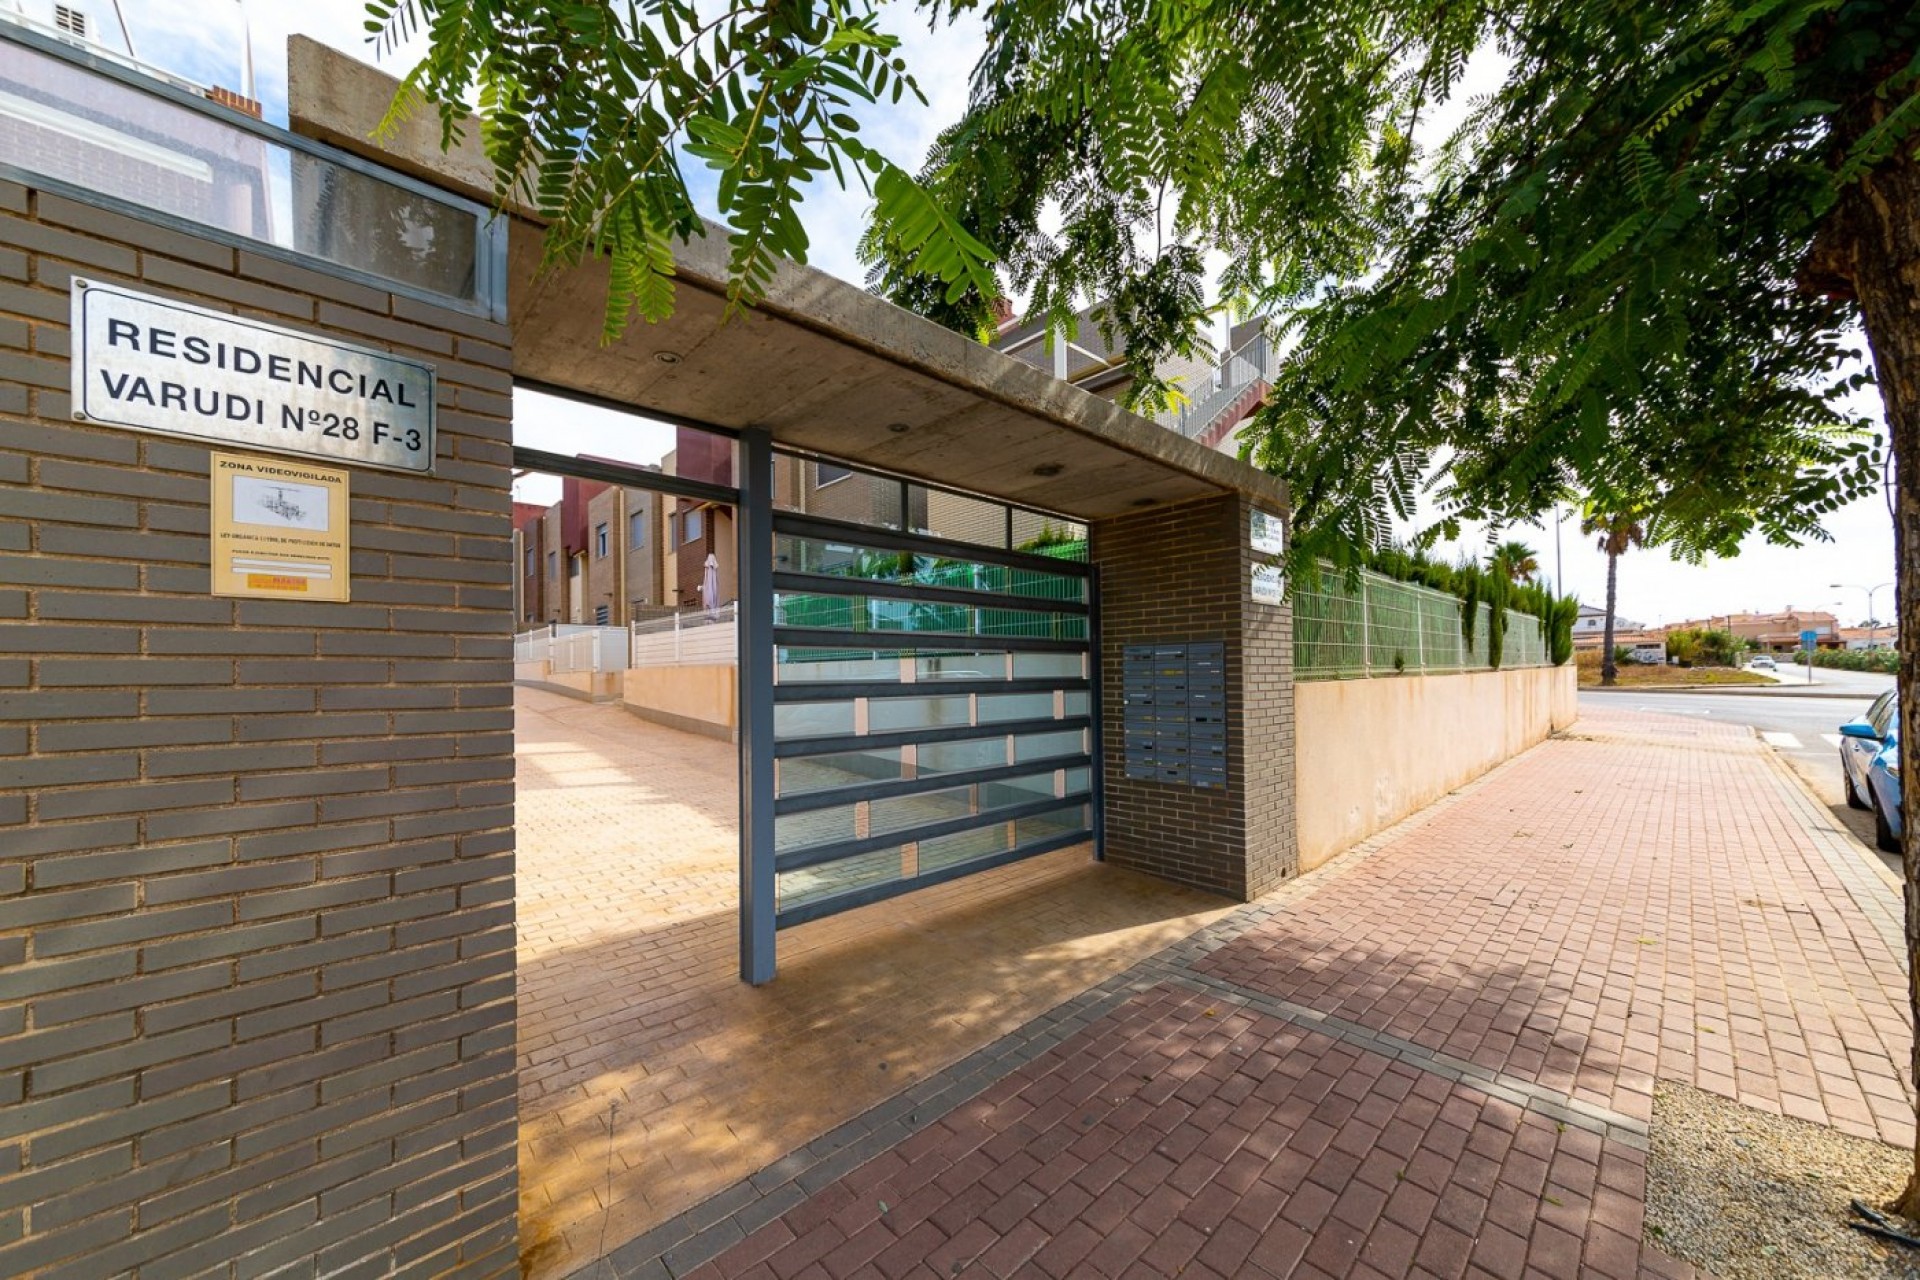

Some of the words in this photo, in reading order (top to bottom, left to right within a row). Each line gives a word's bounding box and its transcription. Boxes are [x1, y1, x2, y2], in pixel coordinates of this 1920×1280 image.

[108, 318, 416, 408] RESIDENCIAL
[100, 369, 263, 424] VARUDI
[281, 404, 359, 441] Nº28
[373, 422, 422, 451] F-3
[219, 460, 253, 472] ZONA
[257, 466, 342, 484] VIDEOVIGILADA
